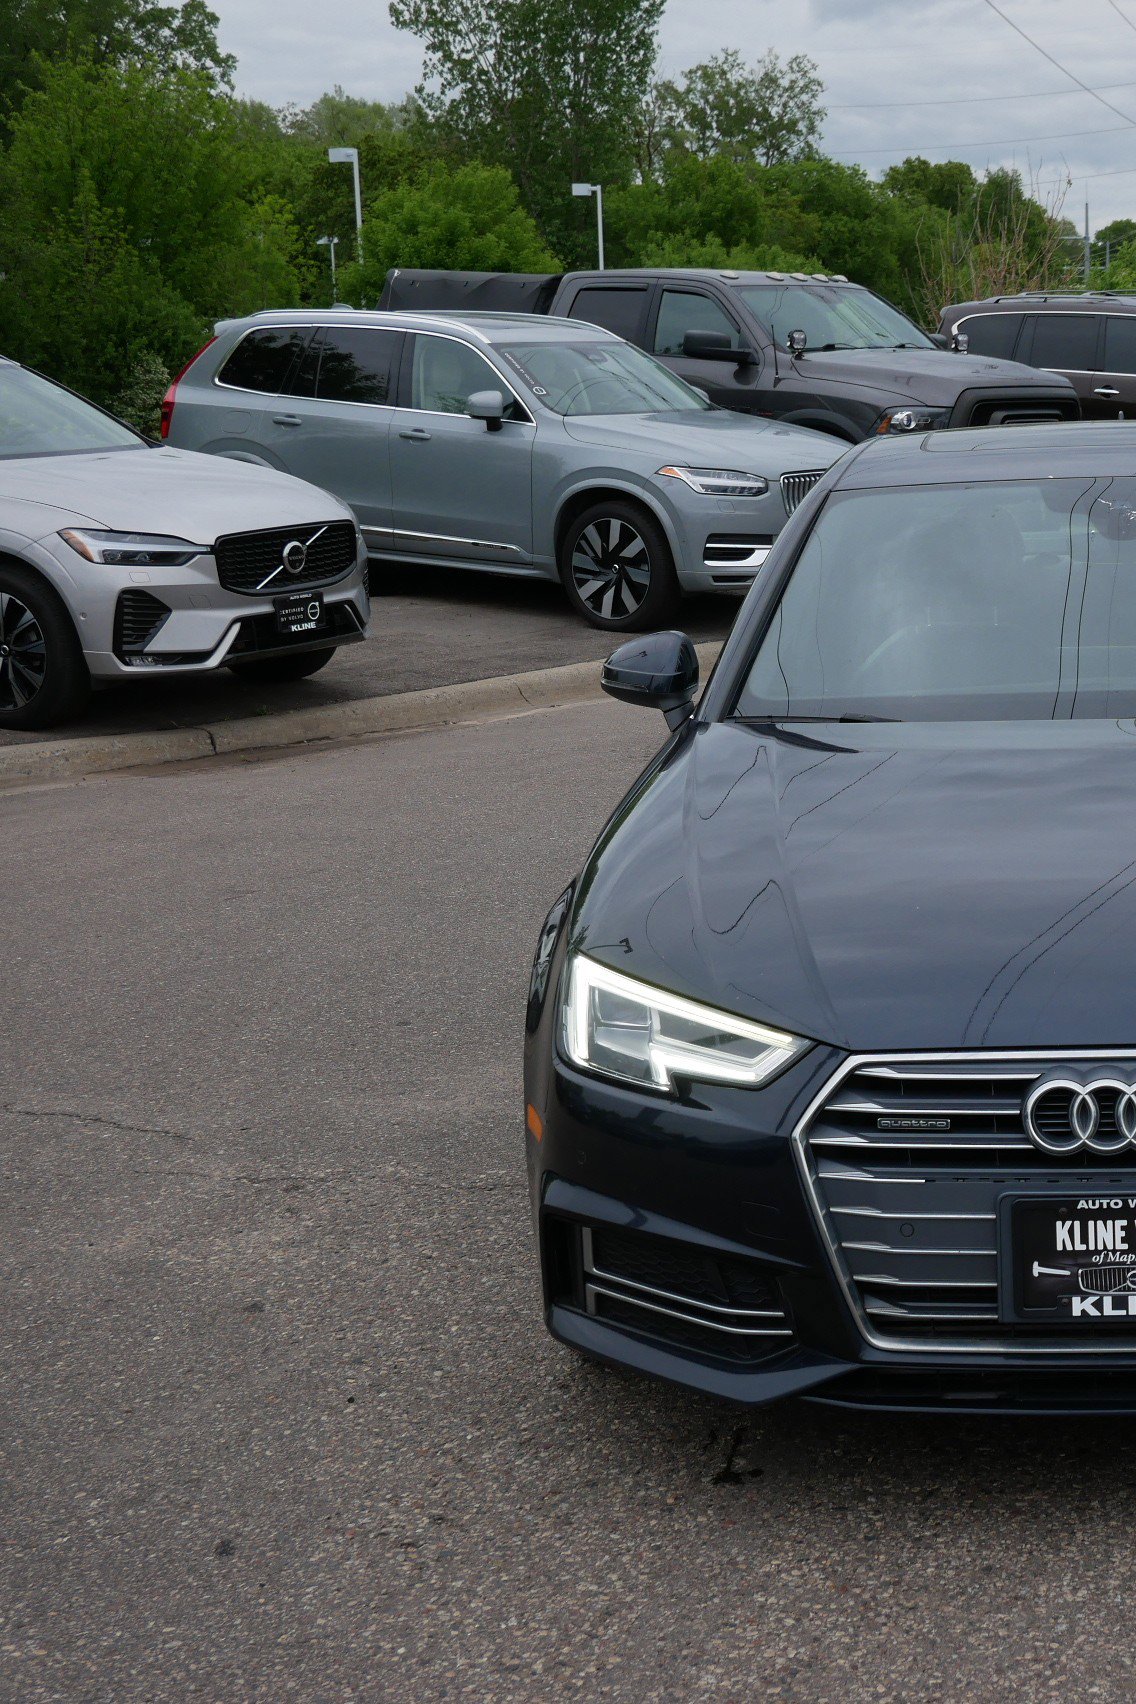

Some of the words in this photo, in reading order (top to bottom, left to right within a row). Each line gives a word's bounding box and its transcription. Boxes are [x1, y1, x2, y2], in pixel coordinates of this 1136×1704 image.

[291, 621, 317, 632] KLINE
[880, 1119, 947, 1128] quattro
[1076, 1198, 1123, 1210] AUTO
[1055, 1219, 1129, 1251] KLINE
[1091, 1251, 1106, 1265] of
